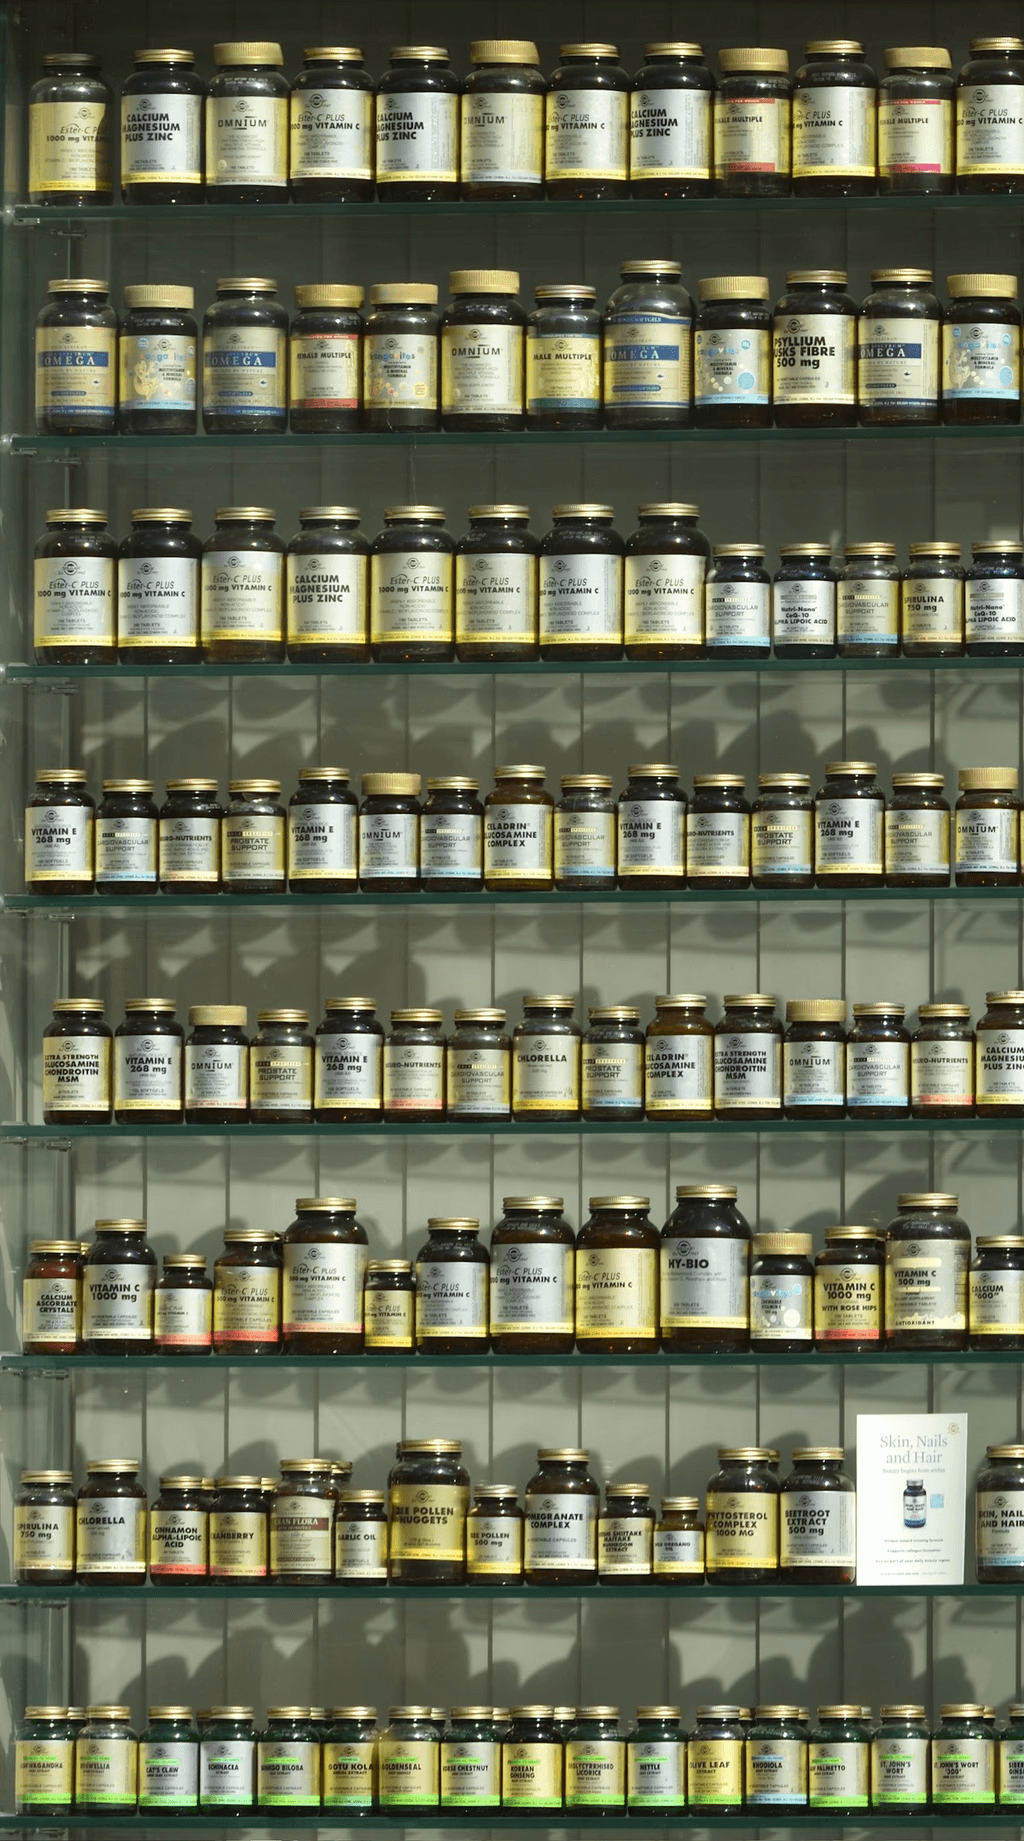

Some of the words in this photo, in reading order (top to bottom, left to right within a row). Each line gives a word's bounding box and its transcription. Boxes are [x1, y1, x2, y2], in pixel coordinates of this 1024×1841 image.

[127, 113, 169, 122] CALCIUM
[978, 117, 1016, 125] VITAMIN
[560, 122, 597, 130] VITAMIN
[600, 122, 605, 130] C
[124, 133, 144, 141] PLUS
[147, 132, 173, 141] ZINC
[801, 347, 835, 356] FIBRE
[861, 348, 906, 358] OMEGA
[44, 356, 95, 365] OMEGA
[776, 358, 796, 367] 500
[800, 358, 820, 369] mg
[80, 581, 99, 589] PLUS
[155, 581, 174, 589] PLUS
[922, 604, 937, 613] mg
[31, 828, 70, 836] VITAMIN
[36, 836, 53, 844] 268
[56, 836, 71, 845] mg
[124, 1057, 165, 1065] VITAMIN
[152, 1065, 167, 1074] mg
[668, 1258, 709, 1269] HY-BIO
[523, 1267, 542, 1275] PLUS
[89, 1284, 132, 1292] VITAMIN
[134, 1284, 140, 1292] C
[823, 1282, 867, 1291] VITAMIN
[870, 1283, 875, 1291] C
[92, 1292, 119, 1301] 1000
[121, 1293, 137, 1302] mg
[827, 1291, 853, 1299] 1000
[856, 1292, 872, 1301] mg
[880, 1436, 913, 1450] Skin,
[916, 1435, 948, 1448] Nails
[886, 1452, 910, 1463] and
[914, 1451, 943, 1463] Hair
[416, 1507, 454, 1516] POLLEN
[785, 1510, 830, 1518] BEETROOT
[531, 1521, 570, 1529] COMPLEX
[713, 1521, 757, 1529] COMPLEX
[786, 1518, 827, 1526] EXTRACT
[20, 1531, 35, 1539] 750
[38, 1532, 52, 1540] mg
[788, 1527, 806, 1535] 500
[808, 1527, 824, 1536] mg
